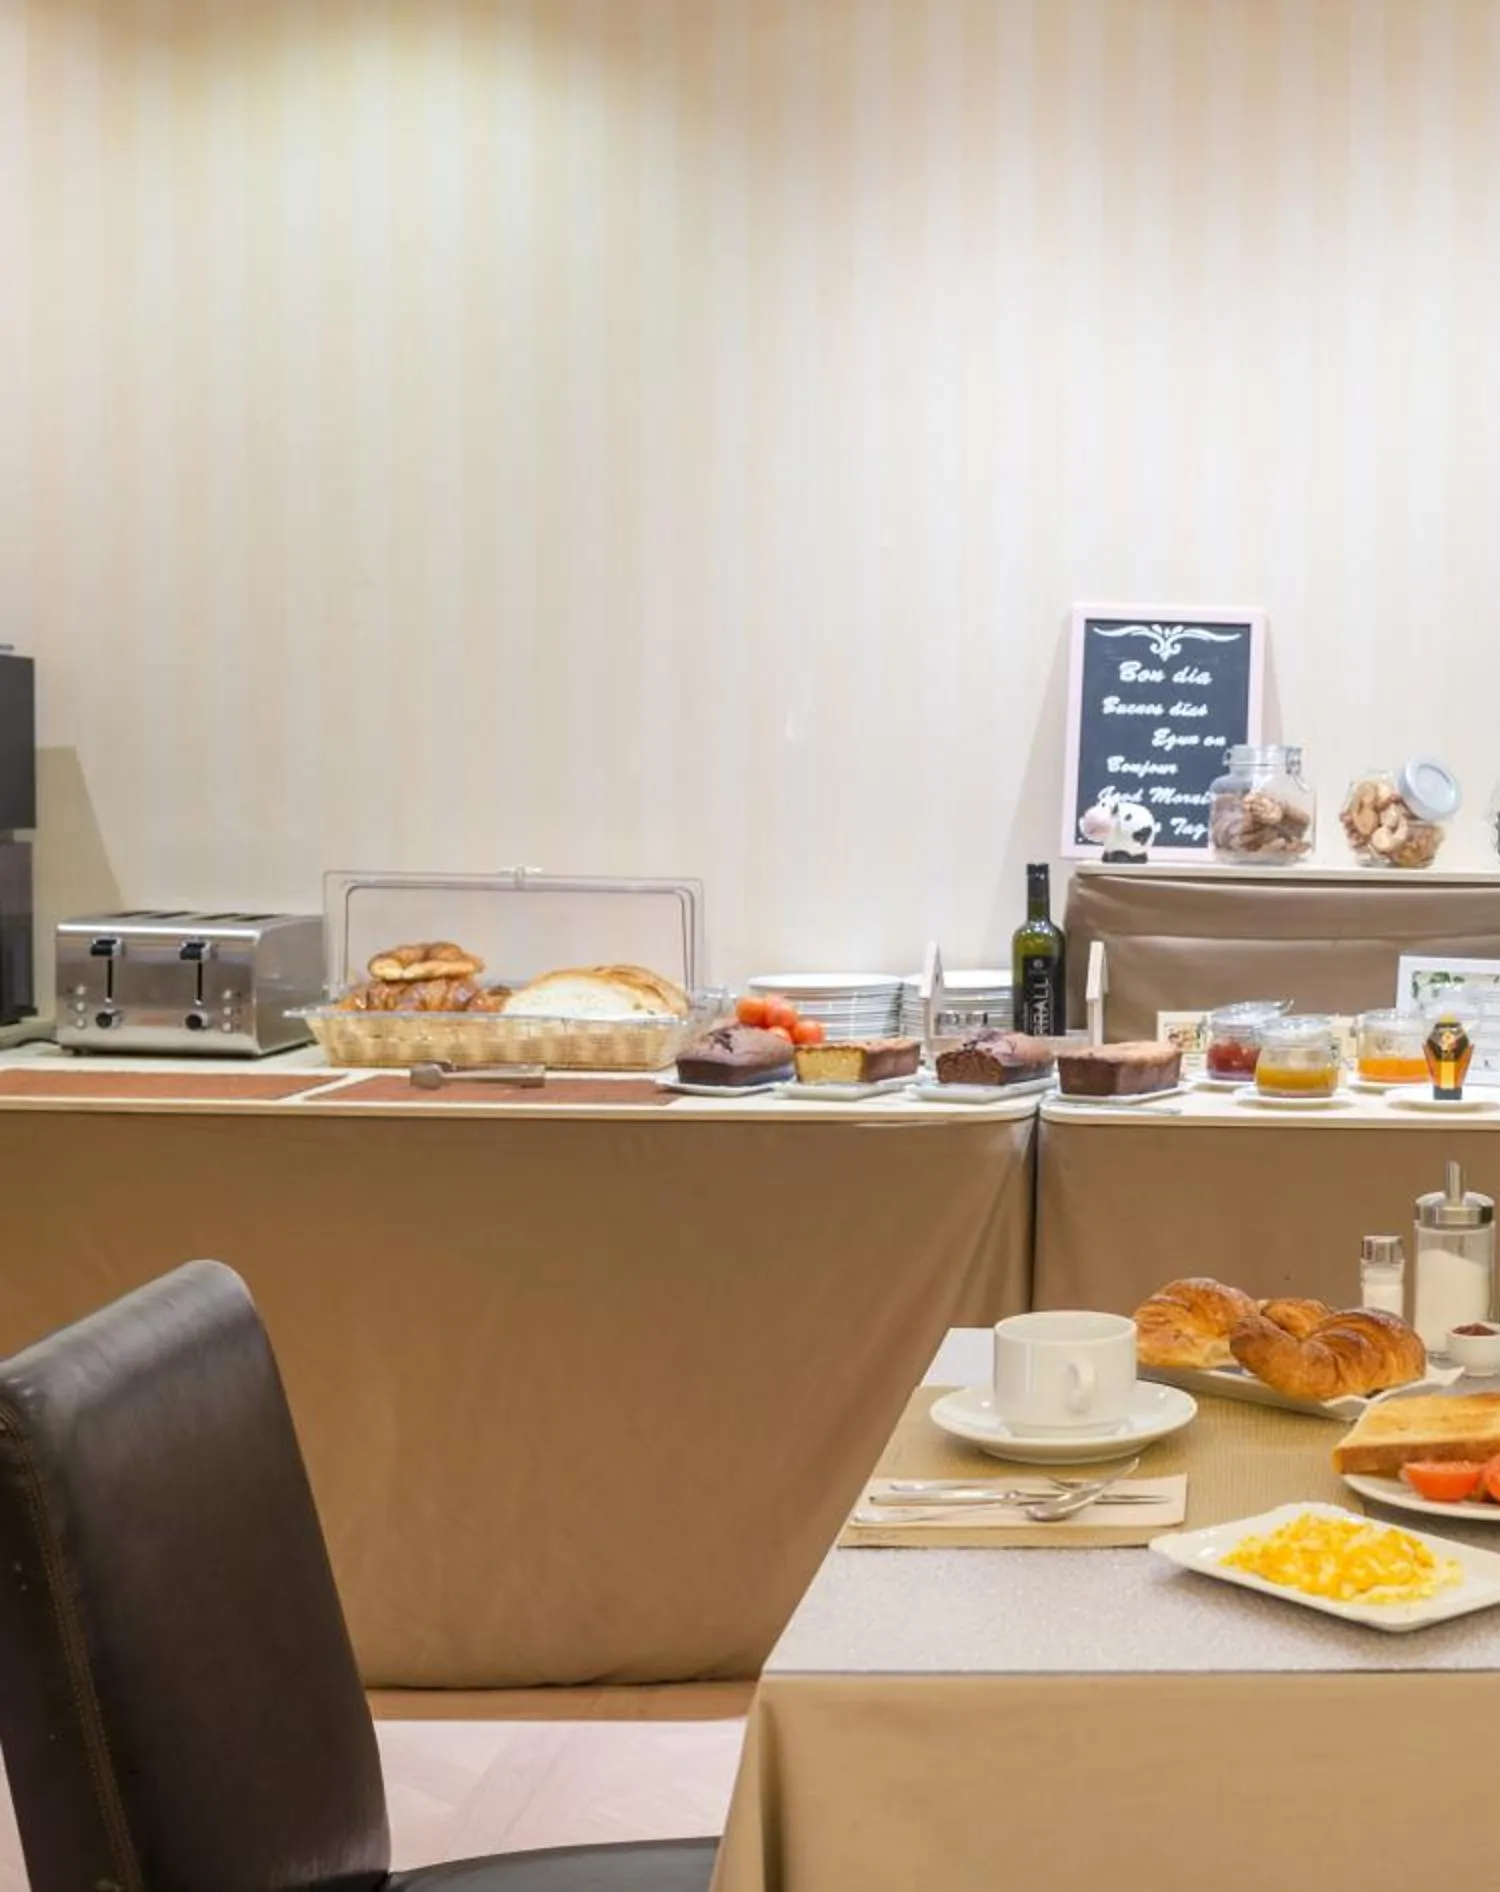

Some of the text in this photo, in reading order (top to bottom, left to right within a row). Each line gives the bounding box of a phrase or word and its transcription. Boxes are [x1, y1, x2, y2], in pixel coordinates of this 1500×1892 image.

[1118, 660, 1165, 682] Bon
[1102, 695, 1164, 716] Buenos
[1151, 727, 1226, 751] Egun on
[1106, 755, 1178, 778] Bonjour
[1148, 786, 1211, 805] Morni
[1169, 817, 1208, 841] Tag
